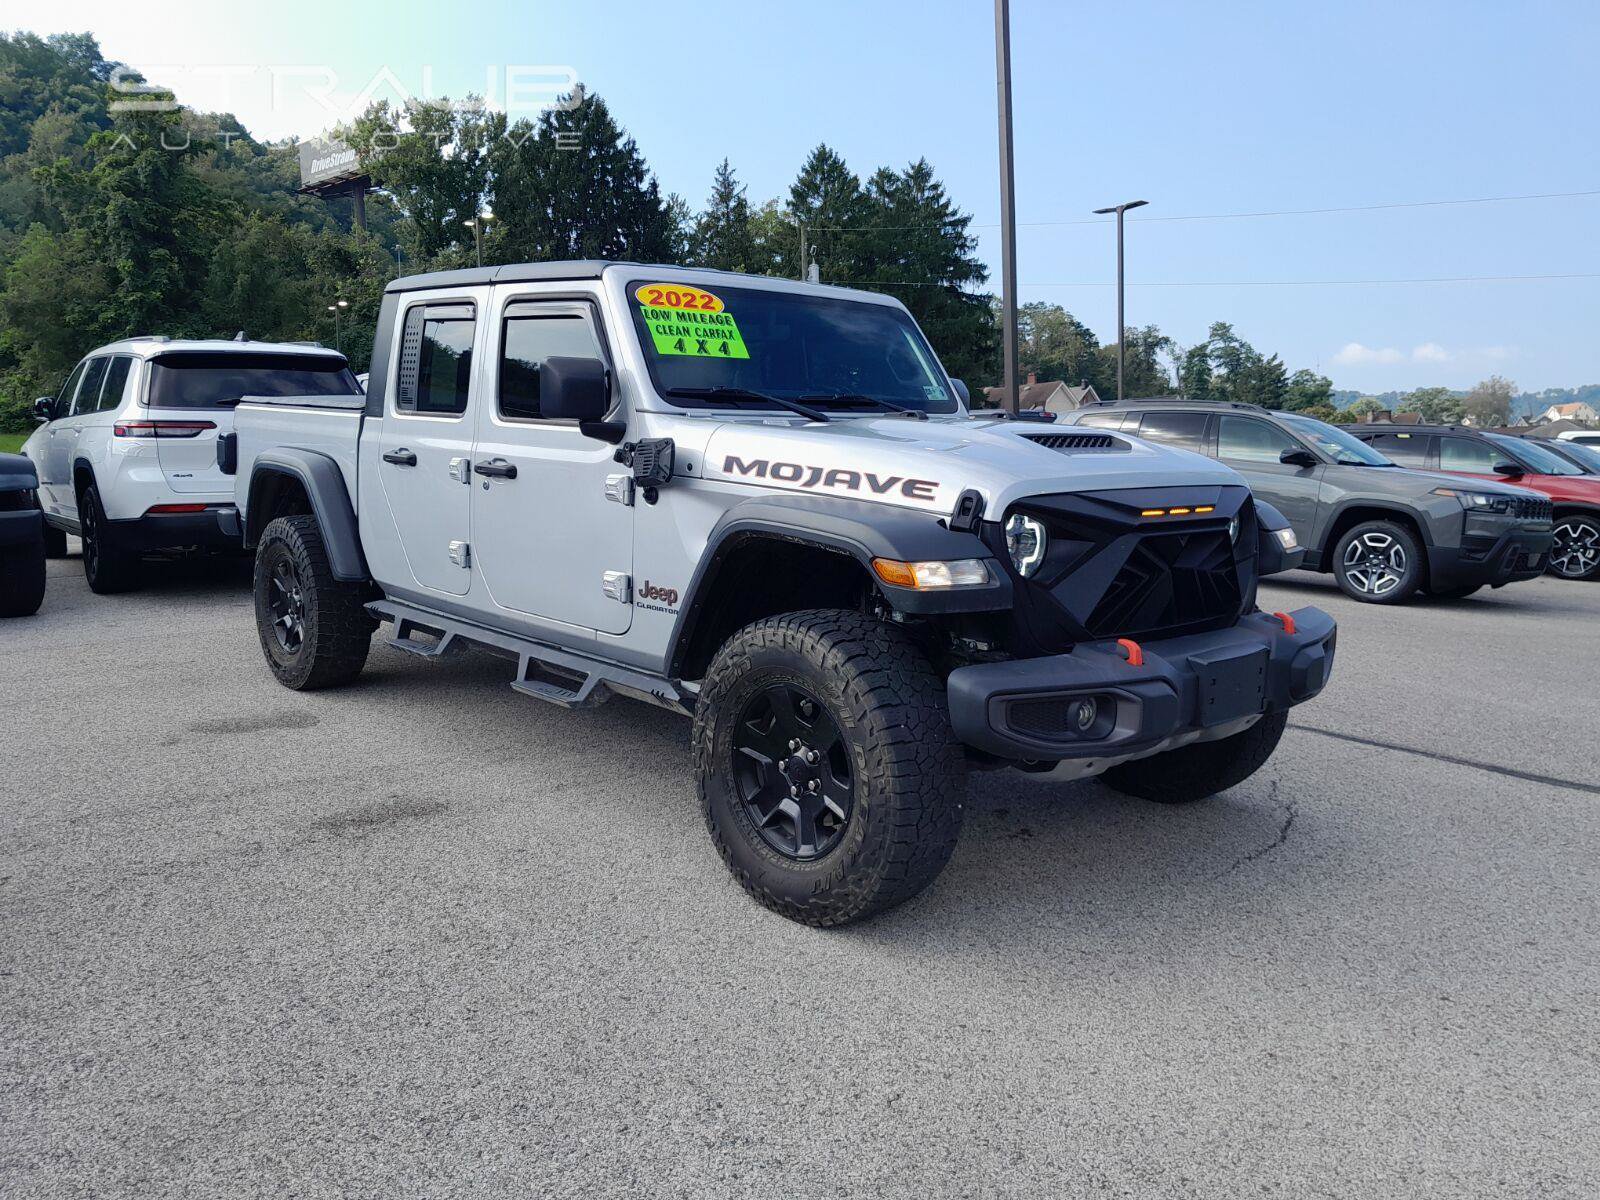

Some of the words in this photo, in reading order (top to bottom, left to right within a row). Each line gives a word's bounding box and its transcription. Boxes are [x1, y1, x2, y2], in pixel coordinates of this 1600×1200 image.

[648, 289, 715, 310] 2022
[643, 308, 672, 321] LOW
[675, 311, 734, 326] MILEAGE
[655, 324, 691, 337] CLEAN
[694, 327, 735, 341] CARFAX
[673, 337, 687, 354] 4
[695, 338, 711, 355] X
[718, 340, 731, 356] 4
[723, 455, 940, 501] MOJAVE
[638, 580, 678, 606] Jeep
[636, 601, 679, 615] GLADIATOR
